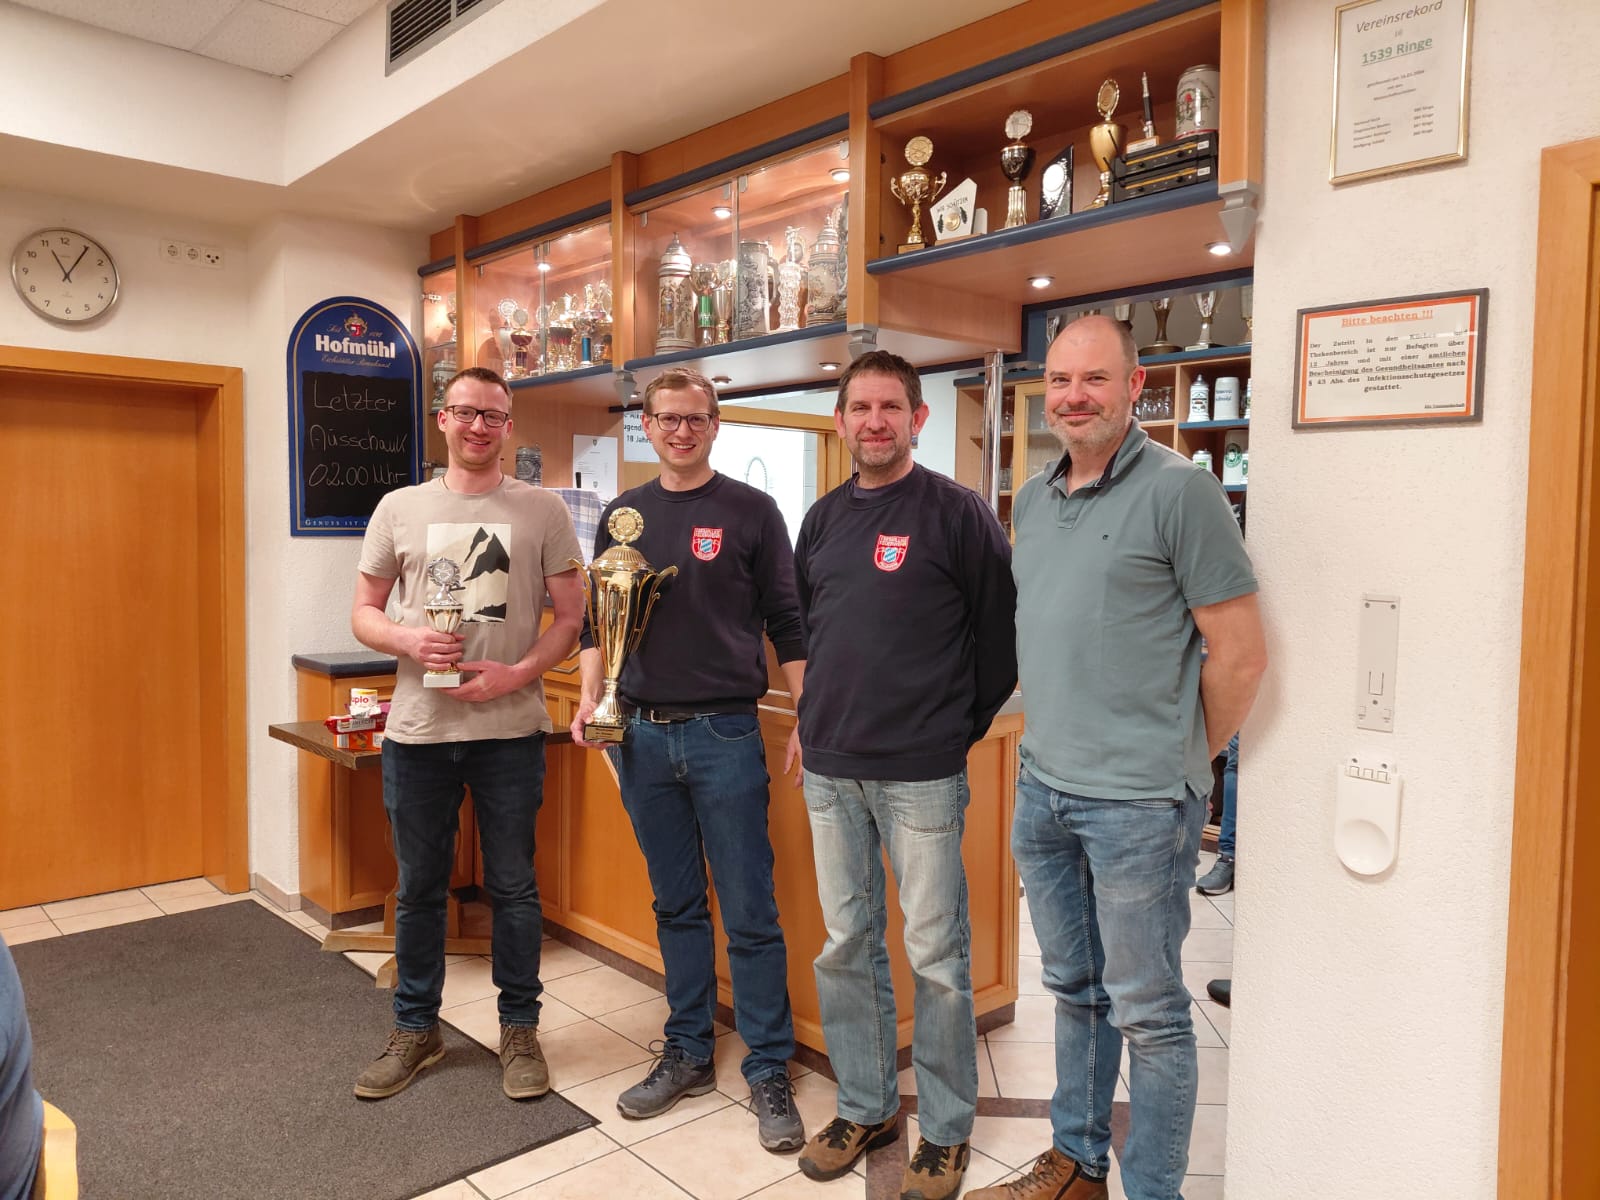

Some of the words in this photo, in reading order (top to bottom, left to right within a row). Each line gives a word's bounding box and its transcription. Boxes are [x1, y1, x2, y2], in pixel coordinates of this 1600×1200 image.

[1356, 0, 1443, 33] Vereinsrekord
[1361, 46, 1393, 65] 1539
[1396, 38, 1433, 56] Ringe
[41, 239, 49, 247] 11
[60, 237, 70, 245] 12
[27, 250, 37, 258] 10
[22, 267, 29, 275] 9
[30, 285, 36, 293] 8
[44, 300, 50, 308] 7
[84, 303, 90, 312] 5
[65, 307, 71, 315] 6
[1341, 317, 1367, 328] Bitte
[1370, 311, 1418, 325] beachten
[315, 334, 396, 359] Hofmühl
[1406, 342, 1438, 350] Befugten
[1428, 350, 1466, 359] amtlichen
[1309, 367, 1359, 377] Bescheinigung
[314, 379, 397, 411] Letzter
[308, 463, 368, 487] 02.00
[372, 464, 407, 486] Uhr
